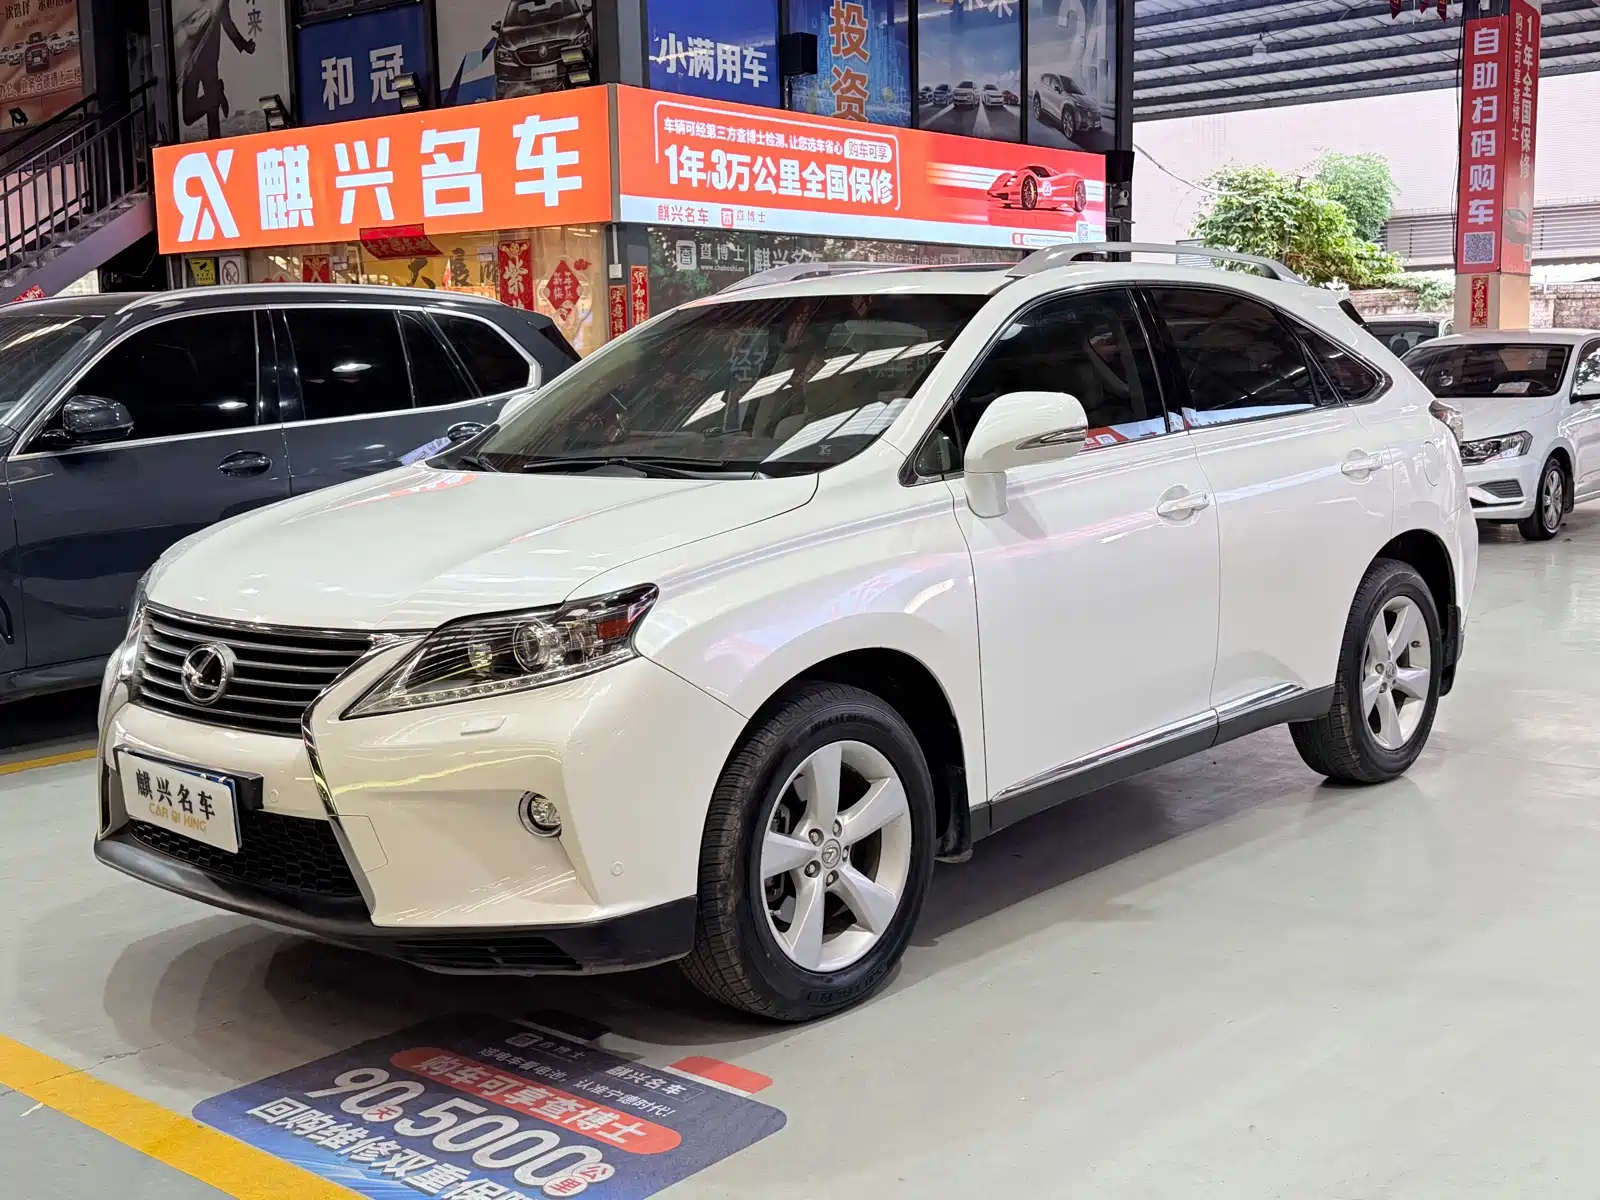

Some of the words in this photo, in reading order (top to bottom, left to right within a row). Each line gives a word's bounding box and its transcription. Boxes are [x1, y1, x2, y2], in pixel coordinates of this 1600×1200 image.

[321, 45, 404, 111] 和冠
[659, 33, 768, 88] 小满用车
[828, 0, 869, 122] 投资
[1520, 15, 1534, 180] 1年全国保修
[849, 141, 888, 161] 购车可享
[1468, 27, 1499, 226] 自助扫码购车
[256, 115, 582, 231] 麒兴名车
[657, 204, 708, 224] 麒兴名车
[700, 243, 744, 262] 查博士
[136, 768, 216, 820] 麒兴名车
[148, 802, 169, 820] CAR
[411, 1054, 648, 1144] 购车可享查博士
[605, 1065, 687, 1096] 麒兴名车
